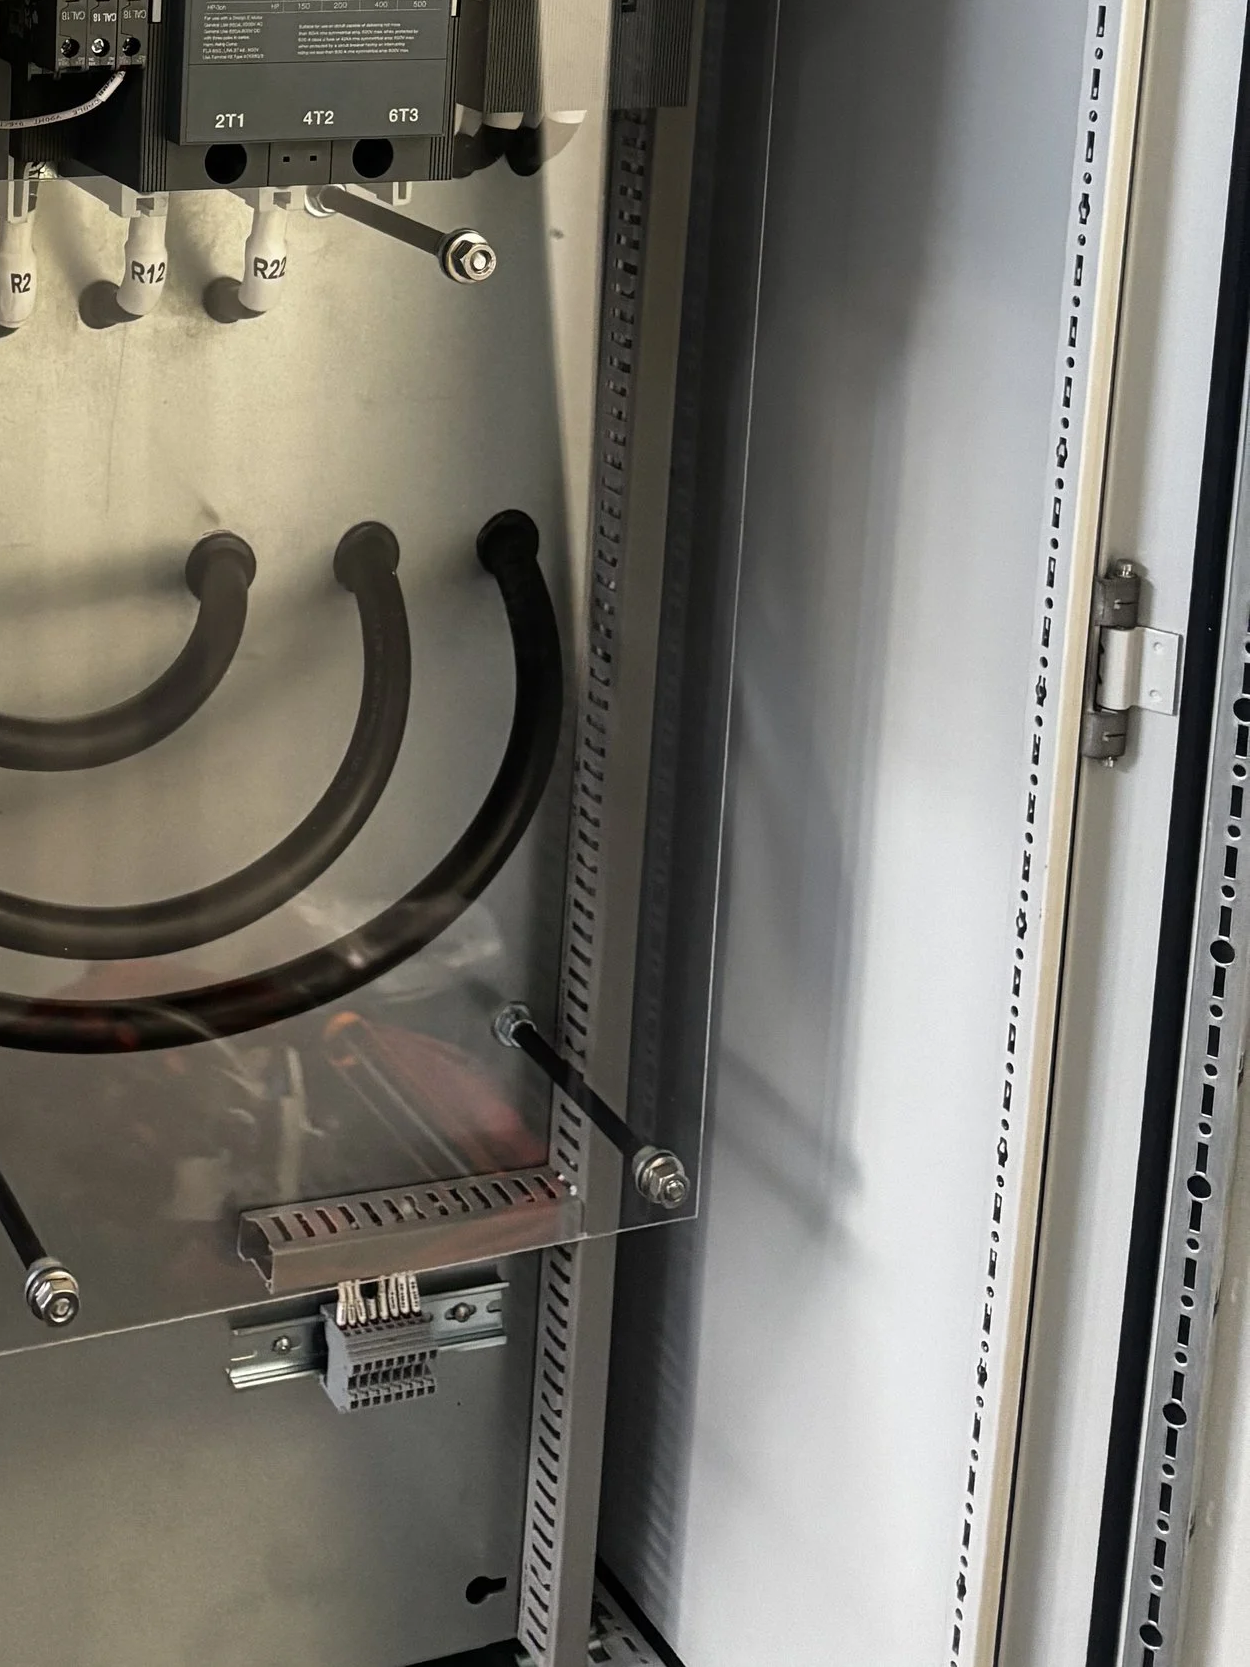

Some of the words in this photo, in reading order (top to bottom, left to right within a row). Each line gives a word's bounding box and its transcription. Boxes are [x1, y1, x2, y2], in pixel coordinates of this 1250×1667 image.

[70, 11, 86, 20] CAL
[93, 13, 101, 22] 18
[103, 13, 117, 22] CAL
[132, 10, 147, 19] CAL
[215, 113, 245, 129] 2T1
[303, 110, 334, 125] 4T2
[388, 108, 419, 123] 6T3
[131, 260, 166, 284] R12
[253, 256, 287, 279] R22
[11, 273, 31, 294] R2
